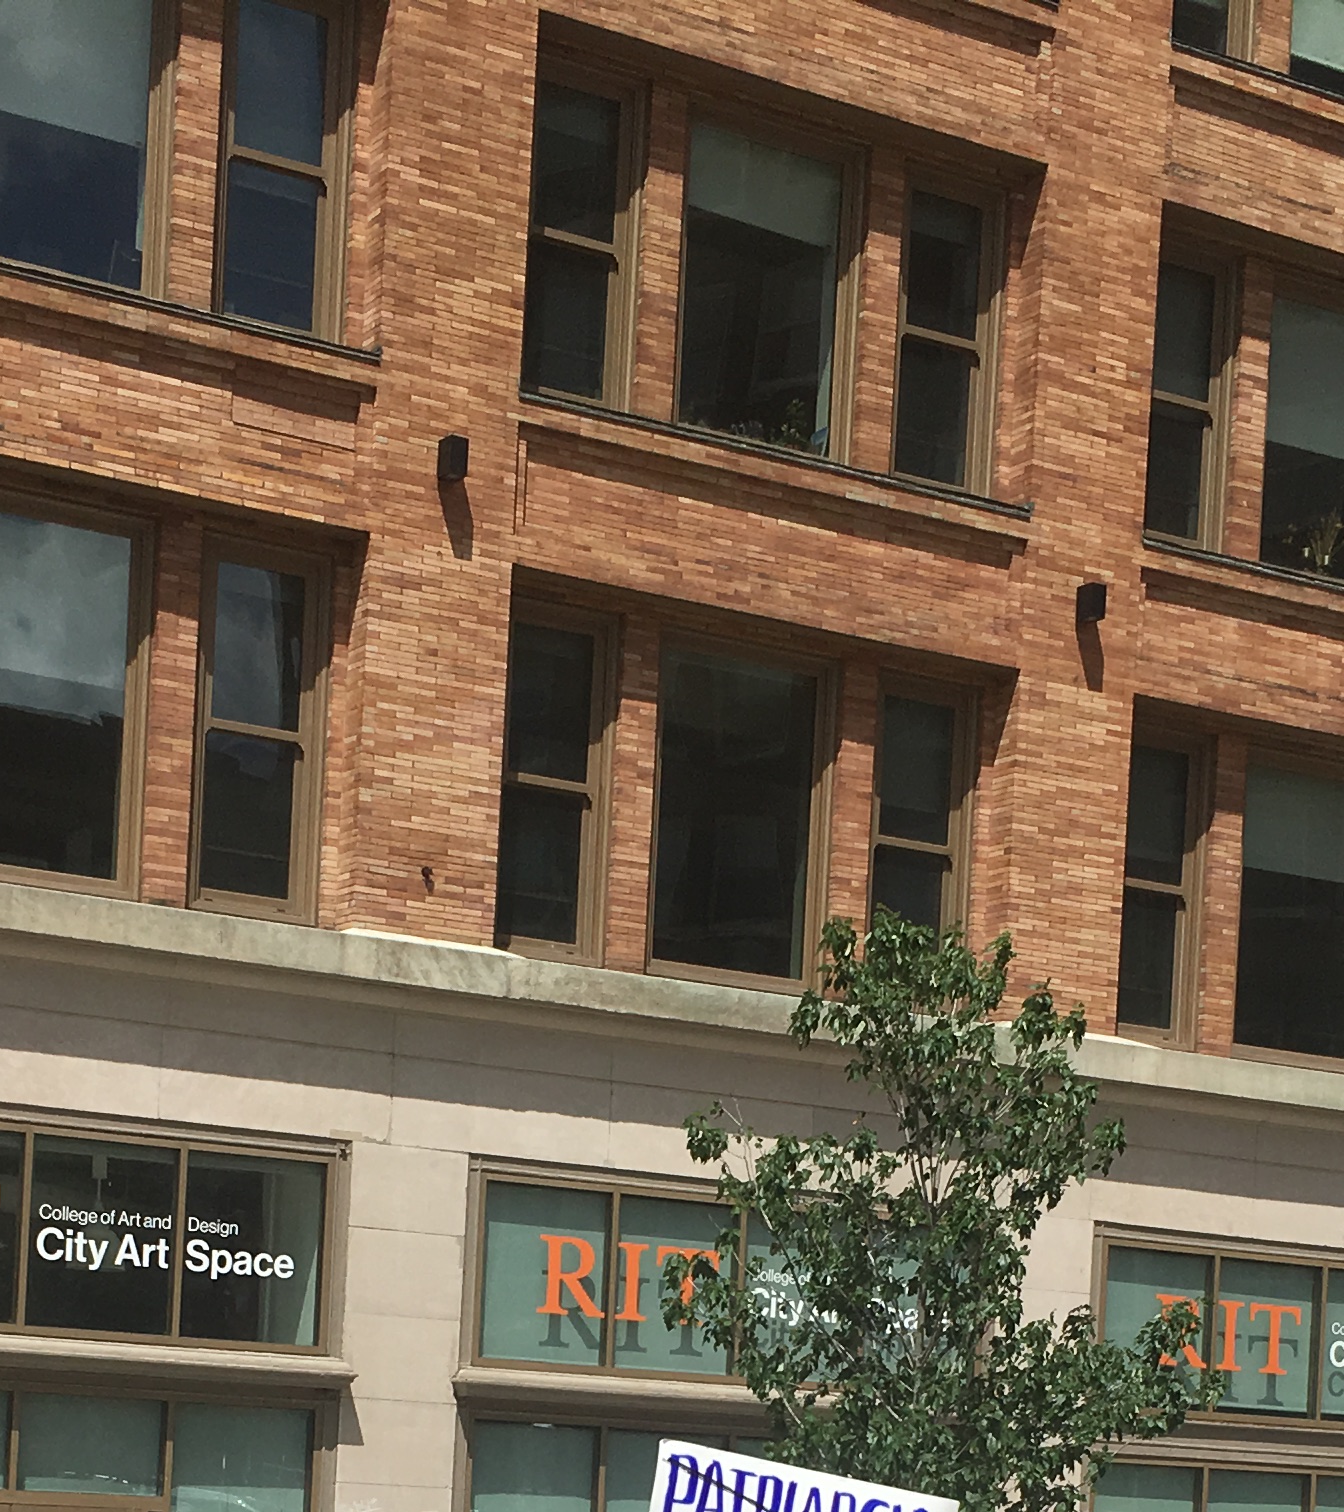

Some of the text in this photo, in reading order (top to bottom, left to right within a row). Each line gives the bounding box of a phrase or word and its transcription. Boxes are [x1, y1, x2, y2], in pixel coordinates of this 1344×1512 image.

[36, 1226, 296, 1280] City Art Space
[38, 1203, 240, 1238] College of Art and Design
[535, 1233, 721, 1328] RIT
[1156, 1293, 1302, 1376] RIT
